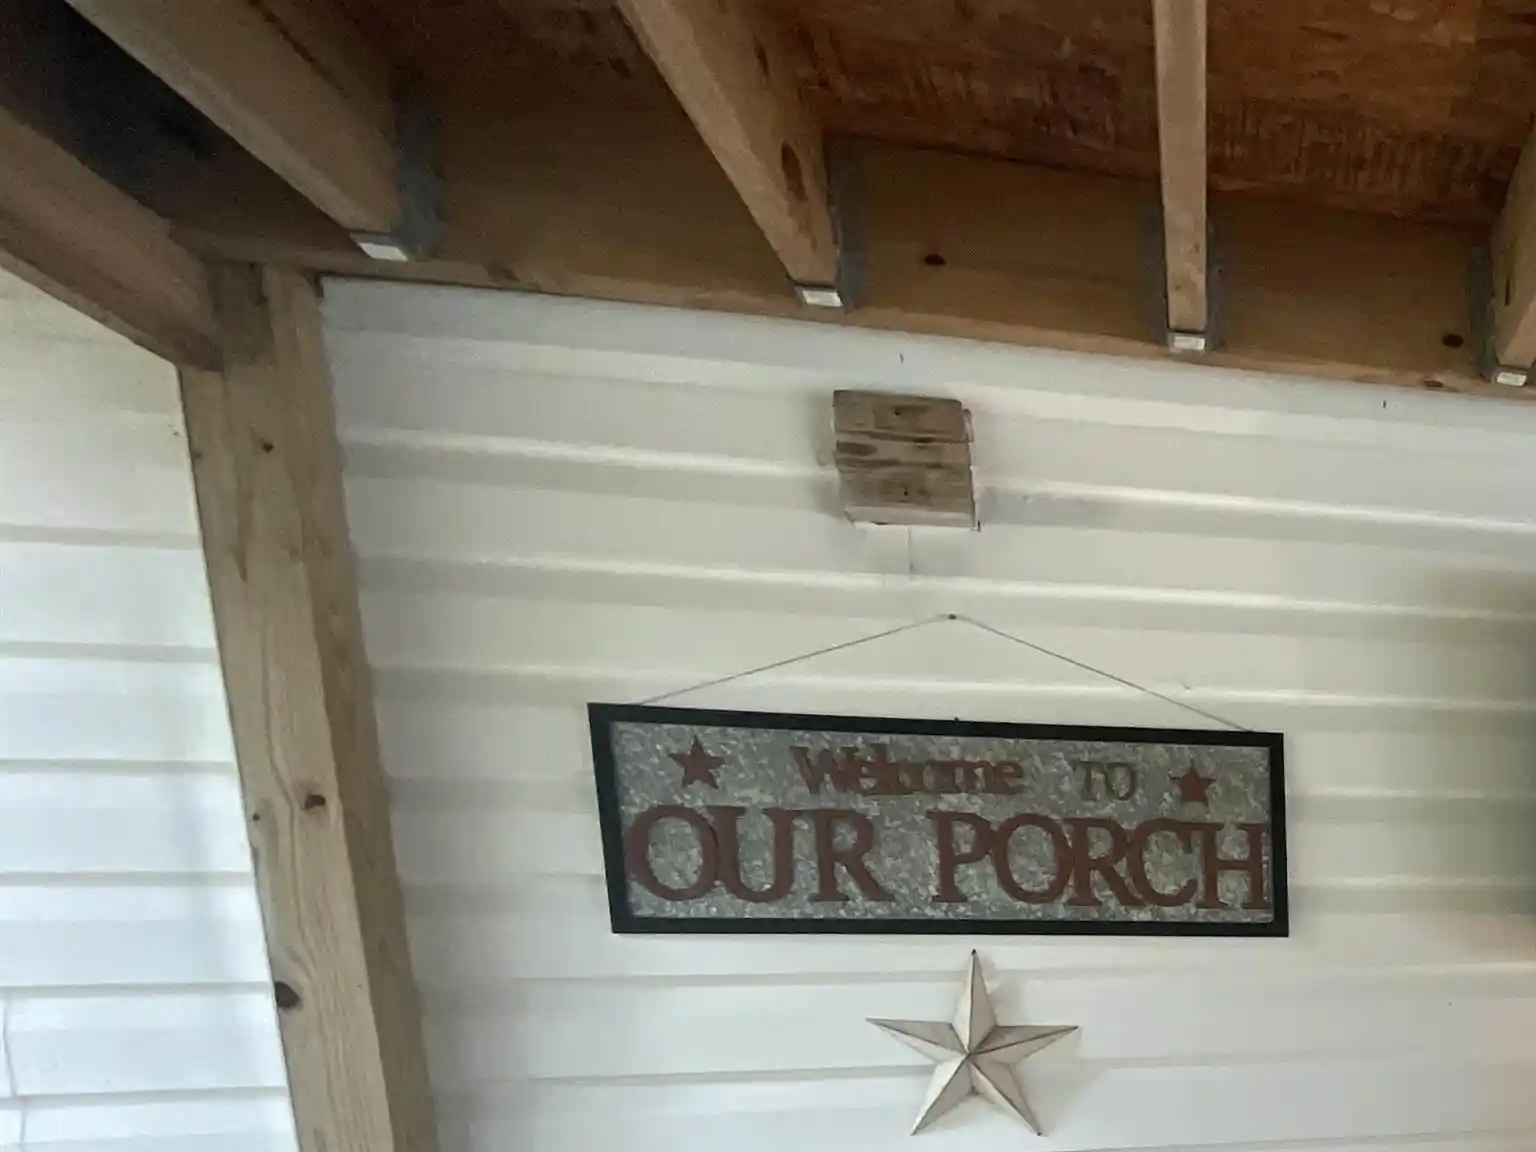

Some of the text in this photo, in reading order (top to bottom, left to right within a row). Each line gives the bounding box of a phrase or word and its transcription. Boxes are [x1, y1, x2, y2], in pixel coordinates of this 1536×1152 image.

[790, 743, 1138, 801] Welcome TO
[623, 803, 1270, 911] OUR PORCH
